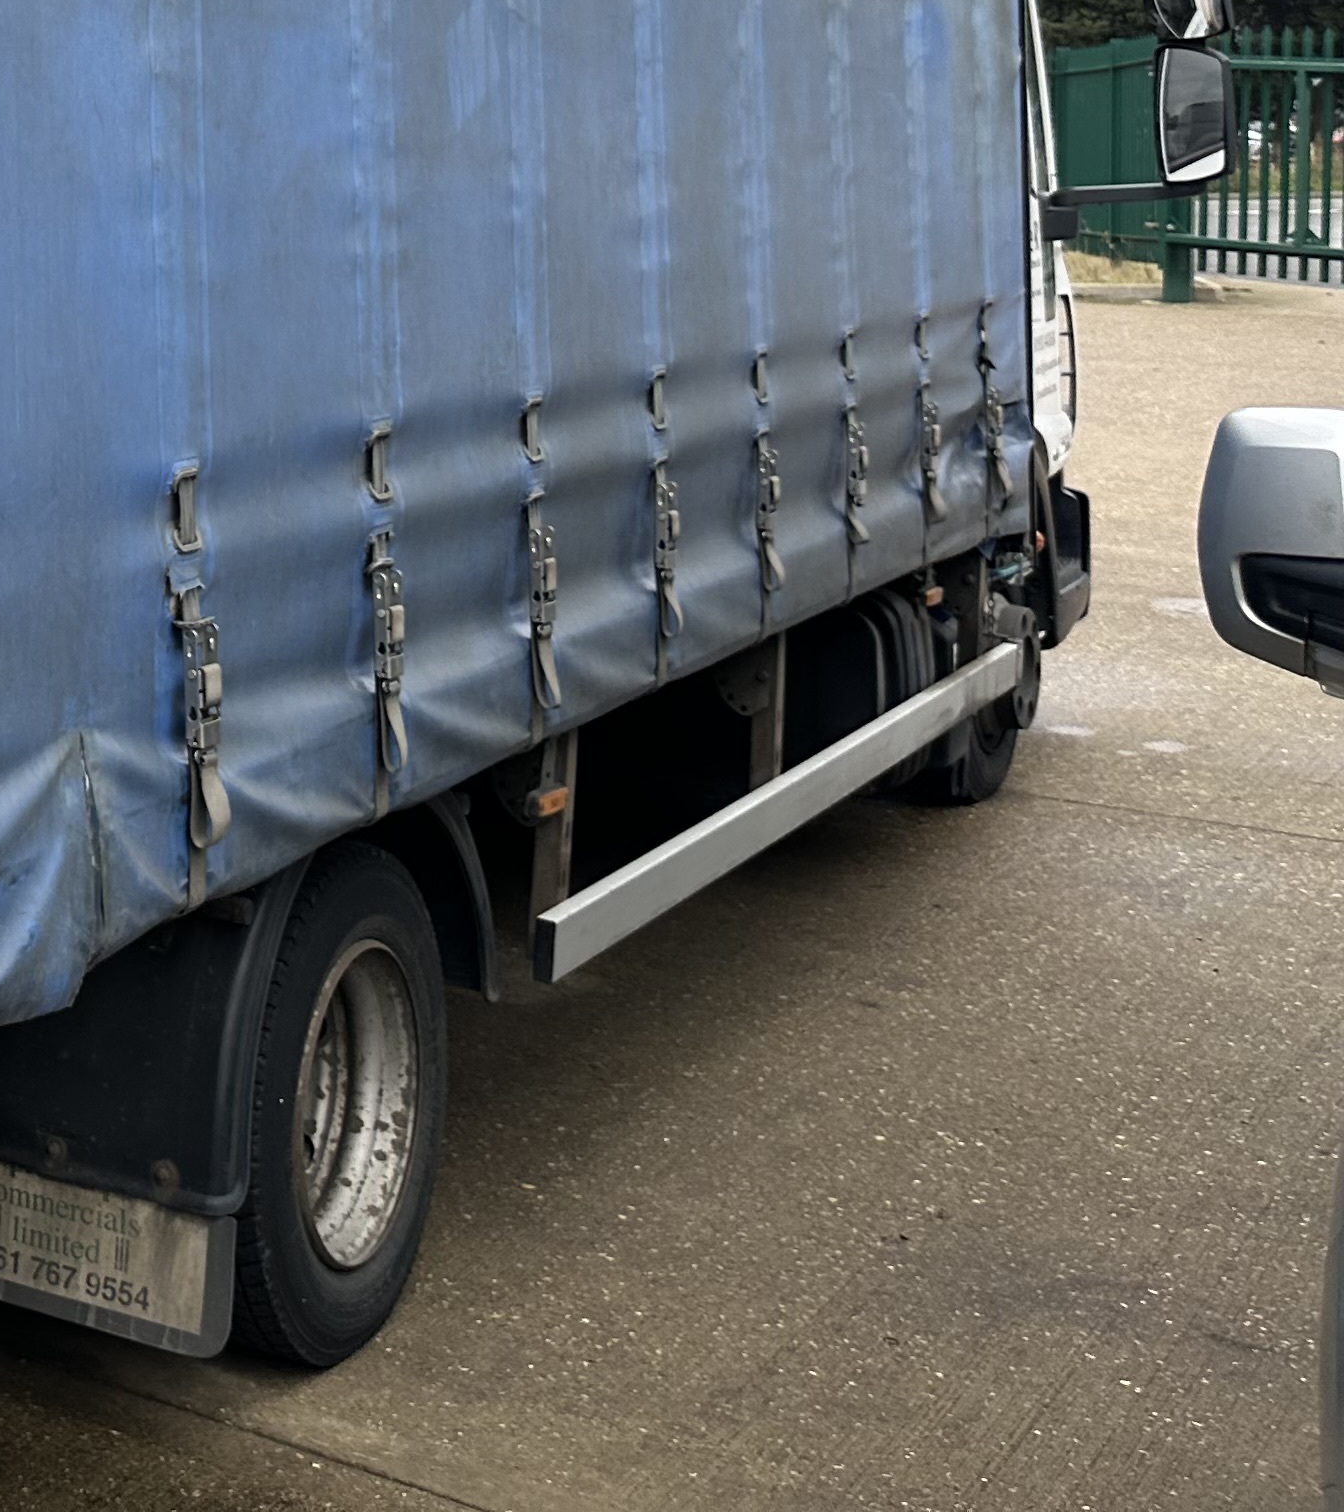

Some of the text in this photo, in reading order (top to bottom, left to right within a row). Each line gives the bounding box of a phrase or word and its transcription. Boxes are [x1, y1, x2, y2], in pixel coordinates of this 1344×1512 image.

[13, 1216, 101, 1265] limited
[31, 1255, 78, 1289] 767
[85, 1271, 150, 1312] 9554
